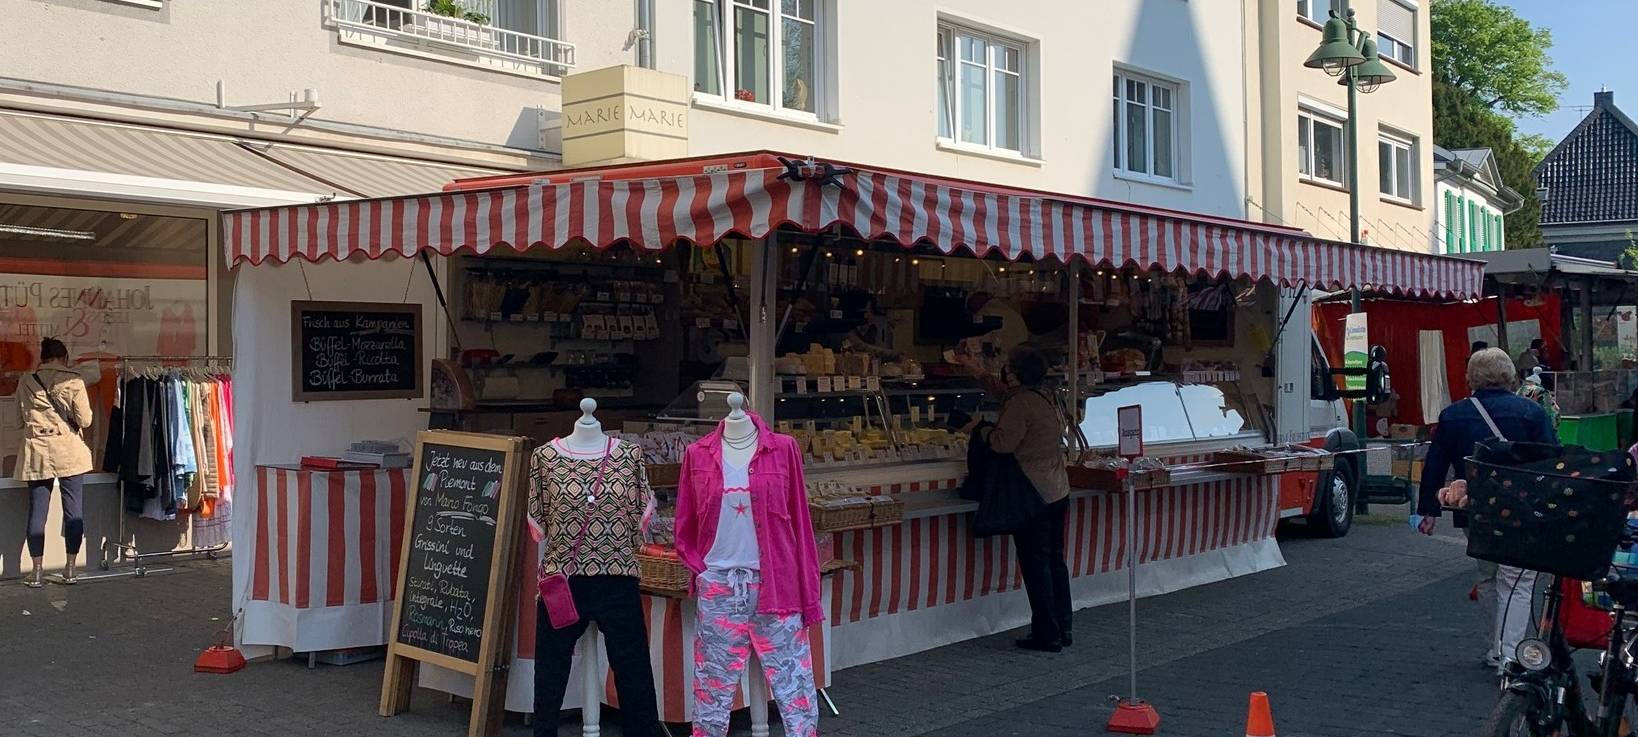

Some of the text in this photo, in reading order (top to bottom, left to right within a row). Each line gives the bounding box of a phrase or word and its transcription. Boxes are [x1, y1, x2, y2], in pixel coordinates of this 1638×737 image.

[567, 105, 619, 128] MARIE
[630, 105, 683, 128] MARIE
[303, 315, 410, 332] Frisch aus Kampanien
[425, 450, 502, 474] Jetzt neu aus dem
[440, 470, 476, 490] Piemont
[420, 496, 432, 506] von
[426, 515, 467, 537] 9 Sorten
[414, 534, 474, 560] Grissini und
[423, 552, 468, 579] Linguette
[430, 630, 438, 644] di
[448, 618, 464, 633] Riso
[465, 625, 481, 638] nero
